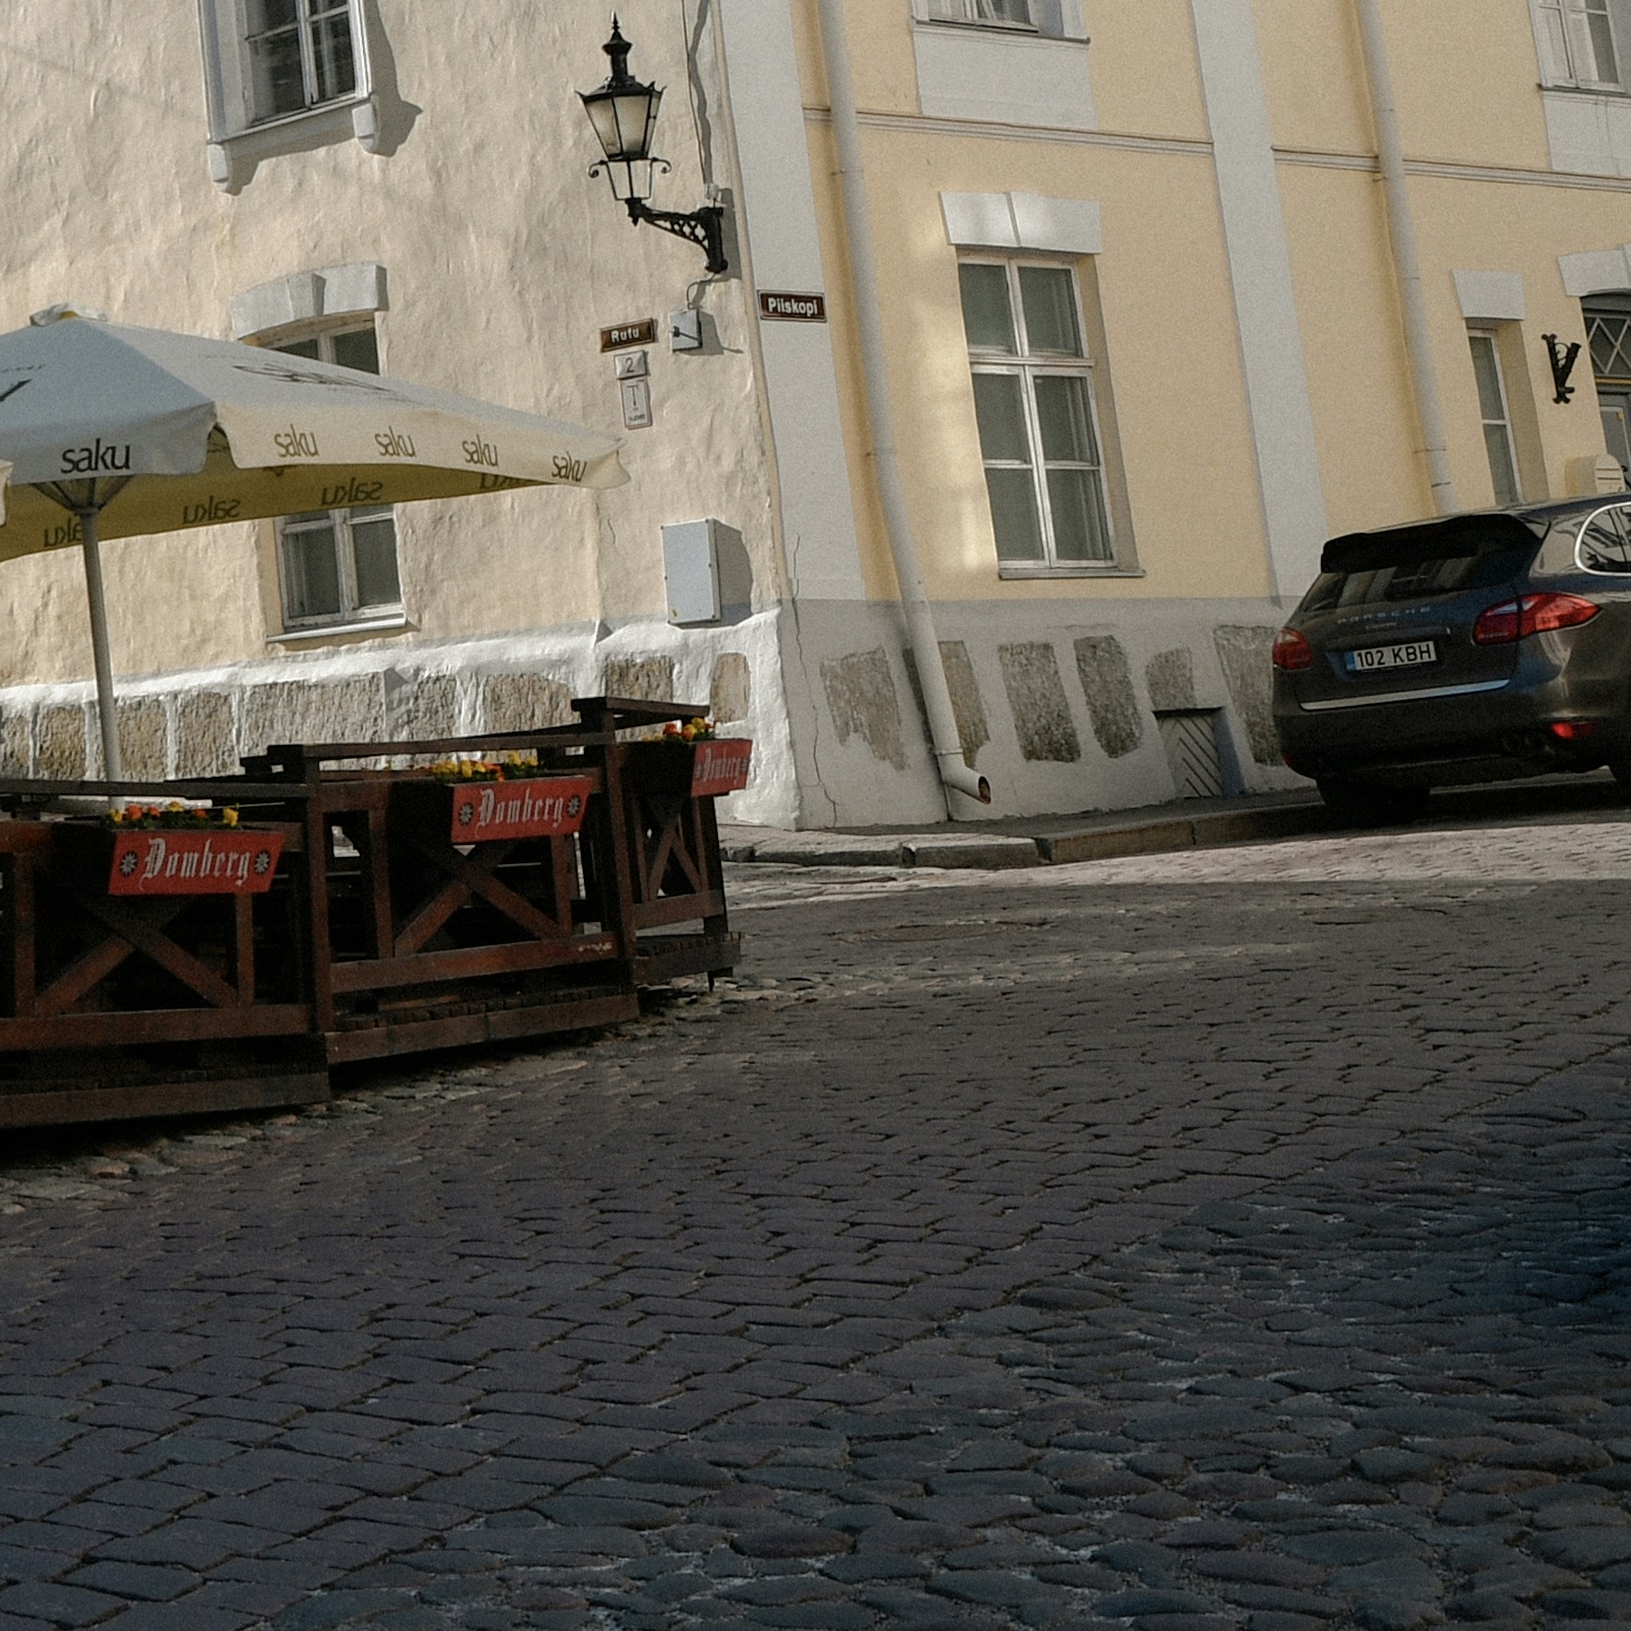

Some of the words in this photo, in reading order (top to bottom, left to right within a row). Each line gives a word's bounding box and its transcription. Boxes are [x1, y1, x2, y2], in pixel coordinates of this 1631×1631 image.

[767, 297, 818, 318] Piiskopi
[625, 357, 635, 373] 2
[61, 437, 131, 474] saku
[274, 424, 320, 458] saku
[374, 425, 416, 459] saku
[462, 433, 499, 467] saku
[551, 451, 587, 483] saku
[1357, 649, 1386, 668] 102
[1392, 642, 1432, 664] KBH
[474, 787, 565, 838] Domberg
[139, 837, 251, 891] Domberg
